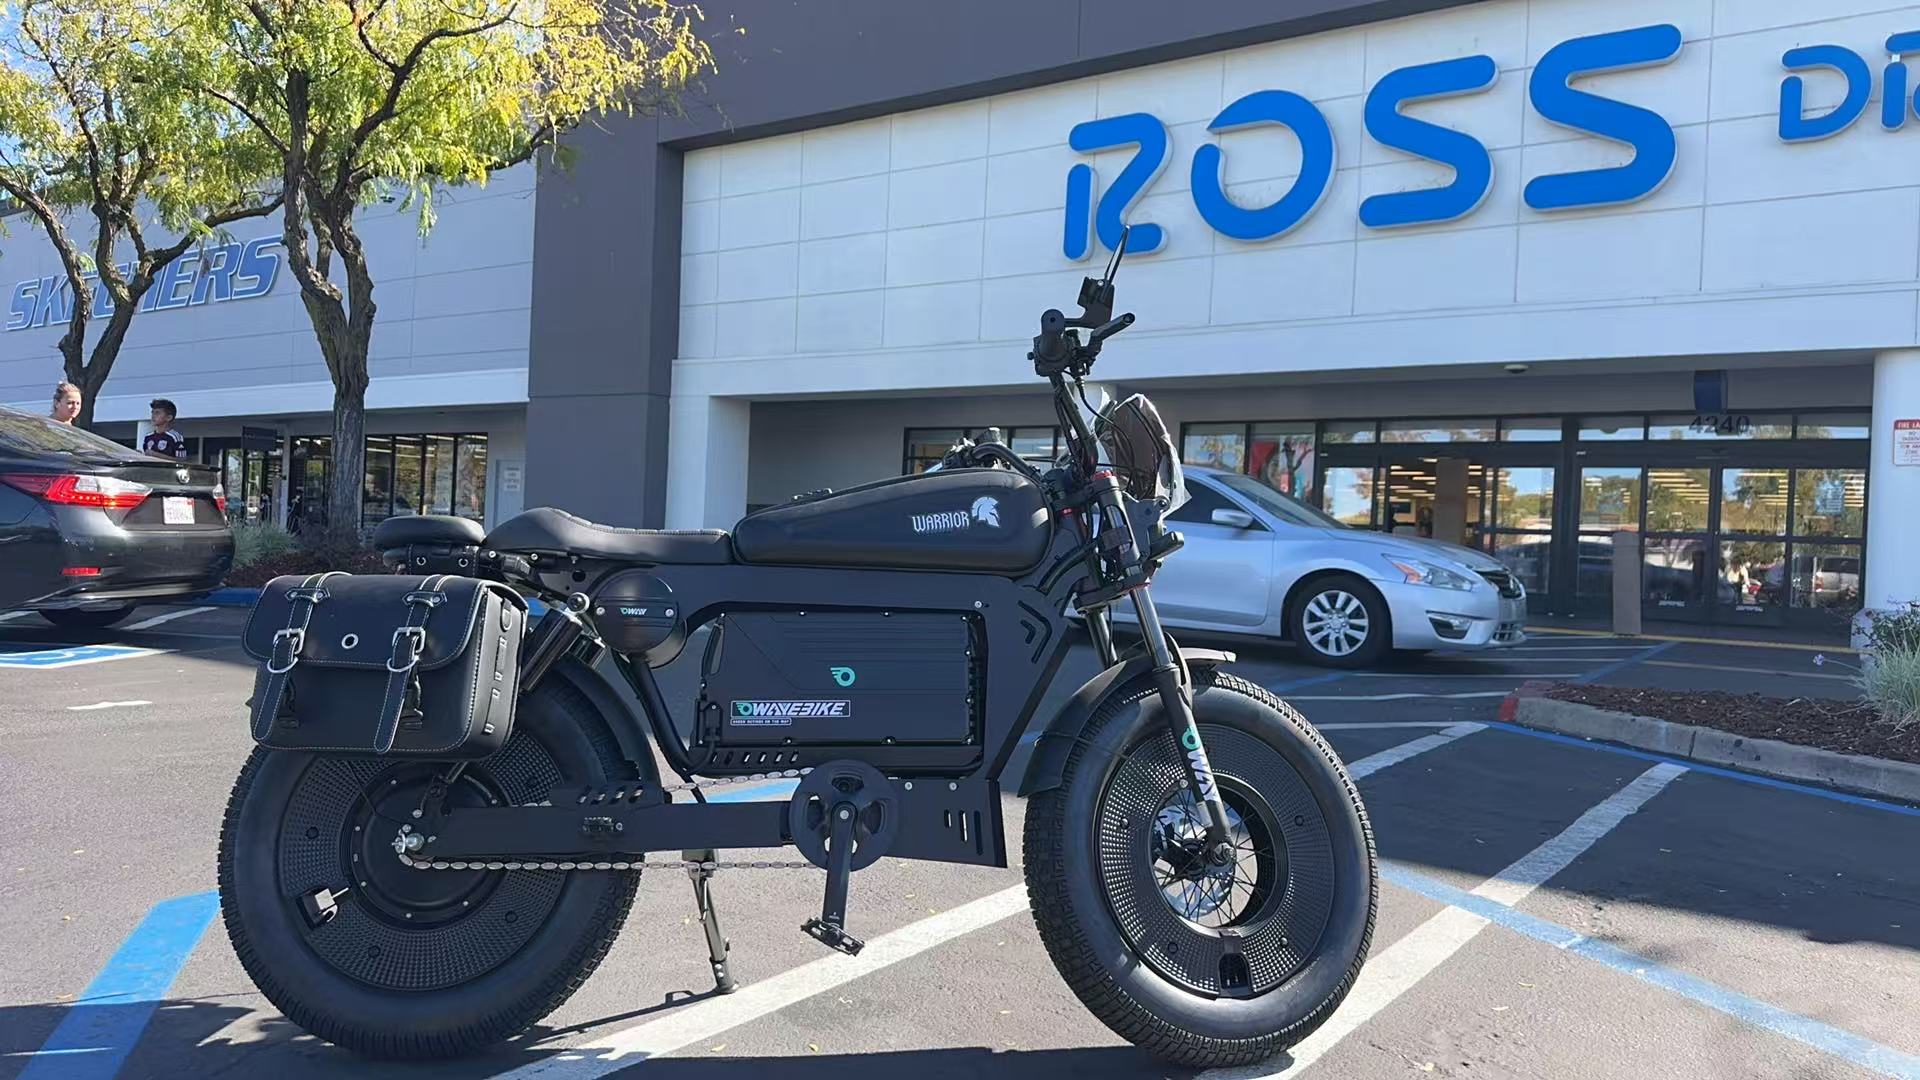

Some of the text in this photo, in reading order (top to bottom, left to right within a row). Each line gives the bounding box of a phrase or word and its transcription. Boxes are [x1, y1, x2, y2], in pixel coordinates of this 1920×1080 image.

[1063, 23, 1920, 262] ROSS DI
[1688, 415, 1751, 433] 4240
[912, 511, 970, 532] WARRIOR
